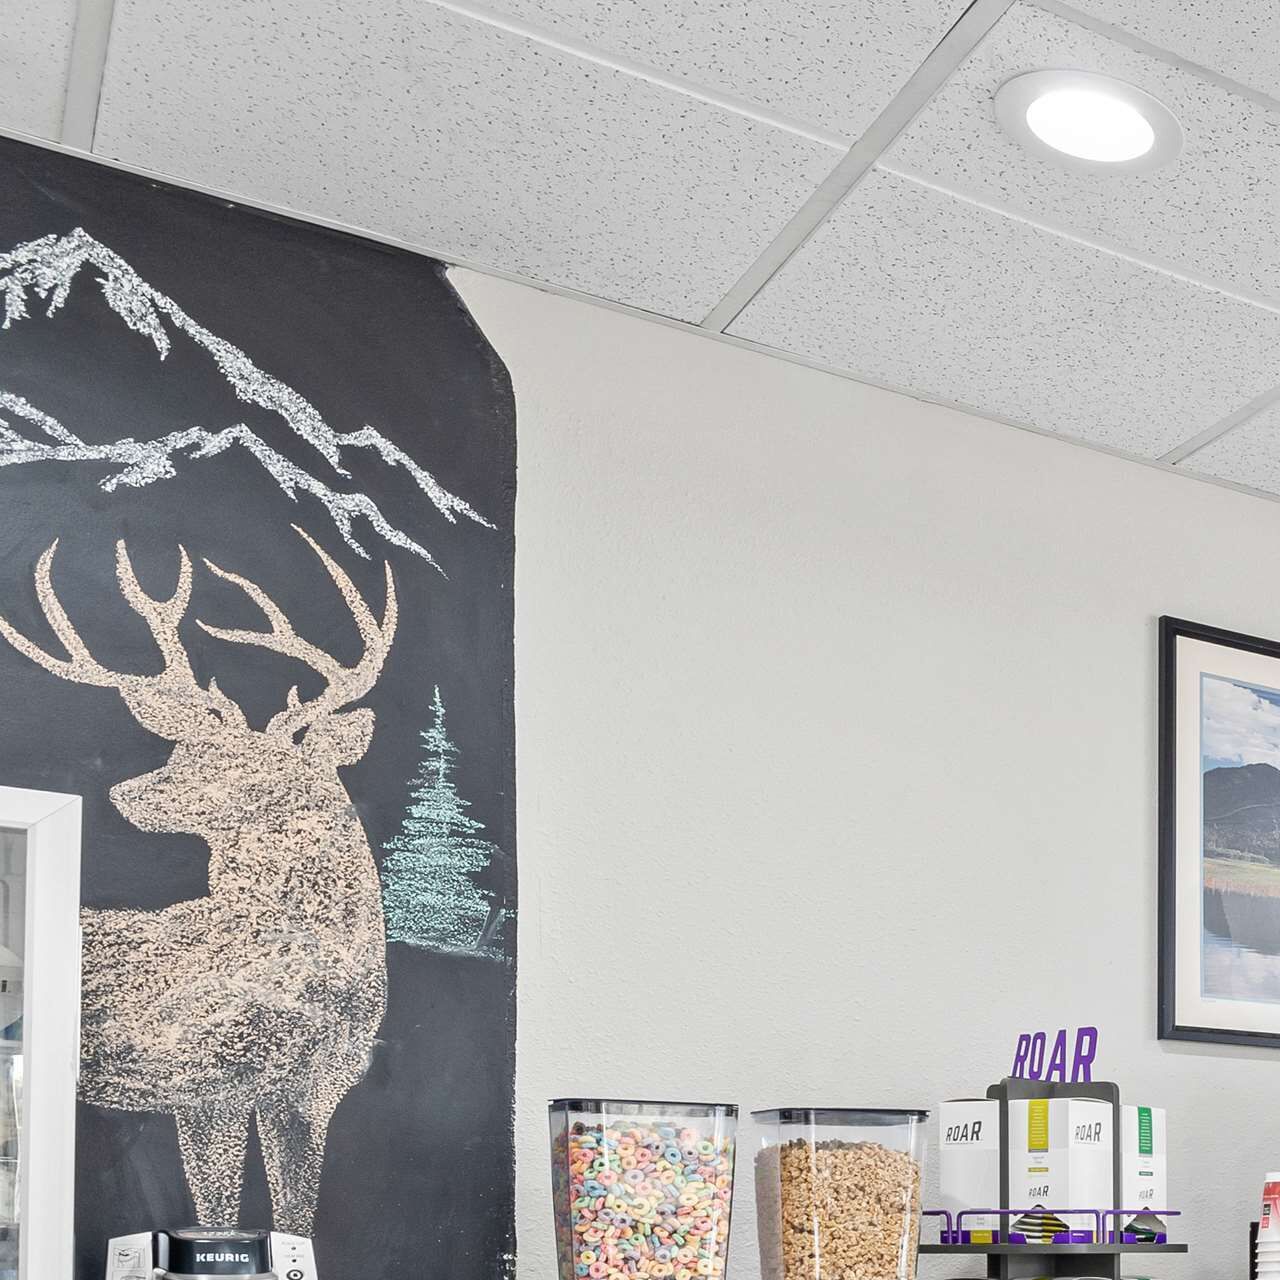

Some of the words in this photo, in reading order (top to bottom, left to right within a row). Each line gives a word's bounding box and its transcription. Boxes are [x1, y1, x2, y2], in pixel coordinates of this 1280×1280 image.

[1011, 1026, 1098, 1083] ROAR
[945, 1121, 982, 1141] ROAR
[1074, 1122, 1102, 1142] ROAR
[1028, 1185, 1049, 1197] ROAR
[195, 1253, 250, 1263] KEURIG
